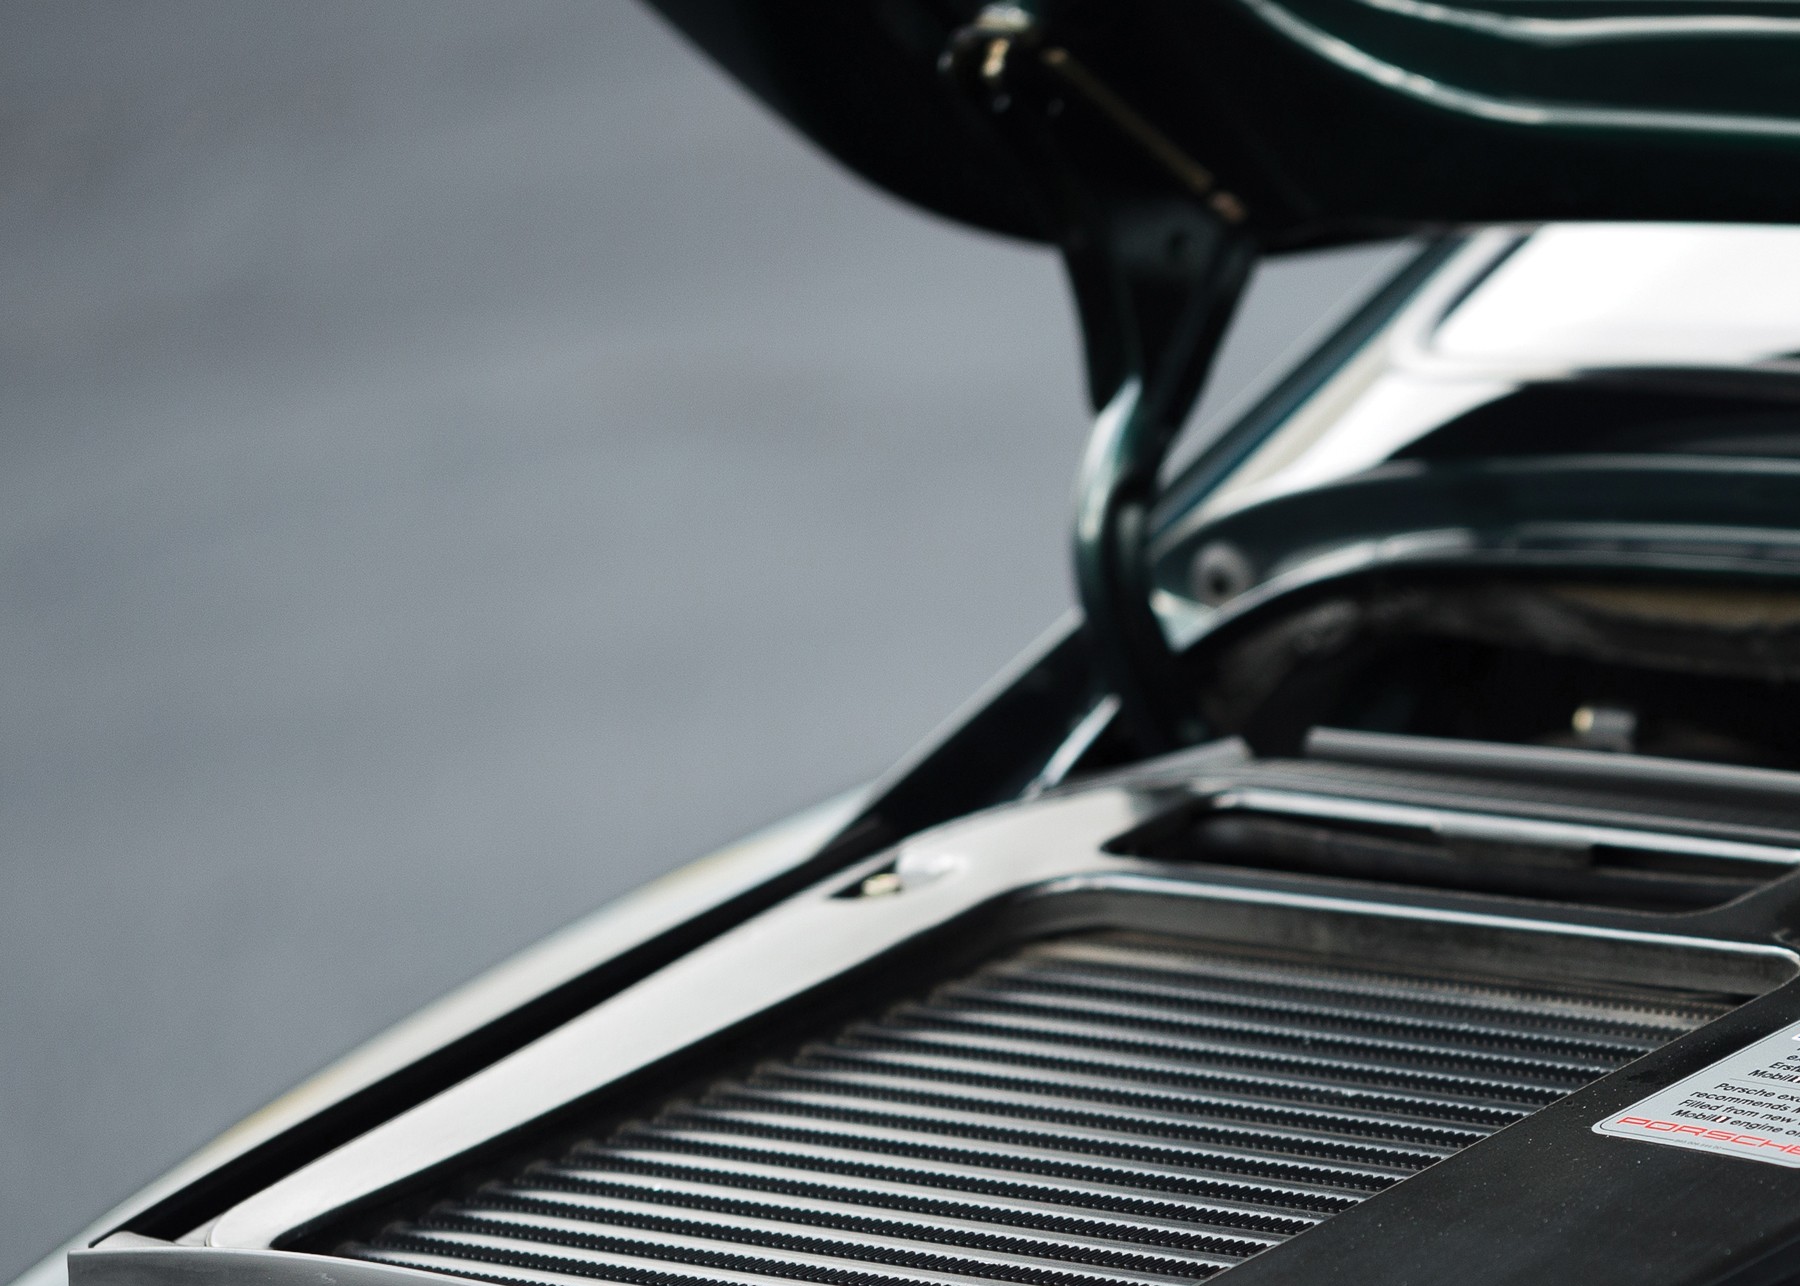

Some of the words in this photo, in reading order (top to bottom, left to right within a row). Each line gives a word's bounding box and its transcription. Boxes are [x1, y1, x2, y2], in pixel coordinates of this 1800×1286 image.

[1713, 1082, 1776, 1097] Porsche
[1689, 1091, 1791, 1111] recommends
[1678, 1099, 1724, 1111] Filled
[1721, 1105, 1760, 1117] from
[1759, 1113, 1797, 1123] new
[1729, 1120, 1783, 1132] engine
